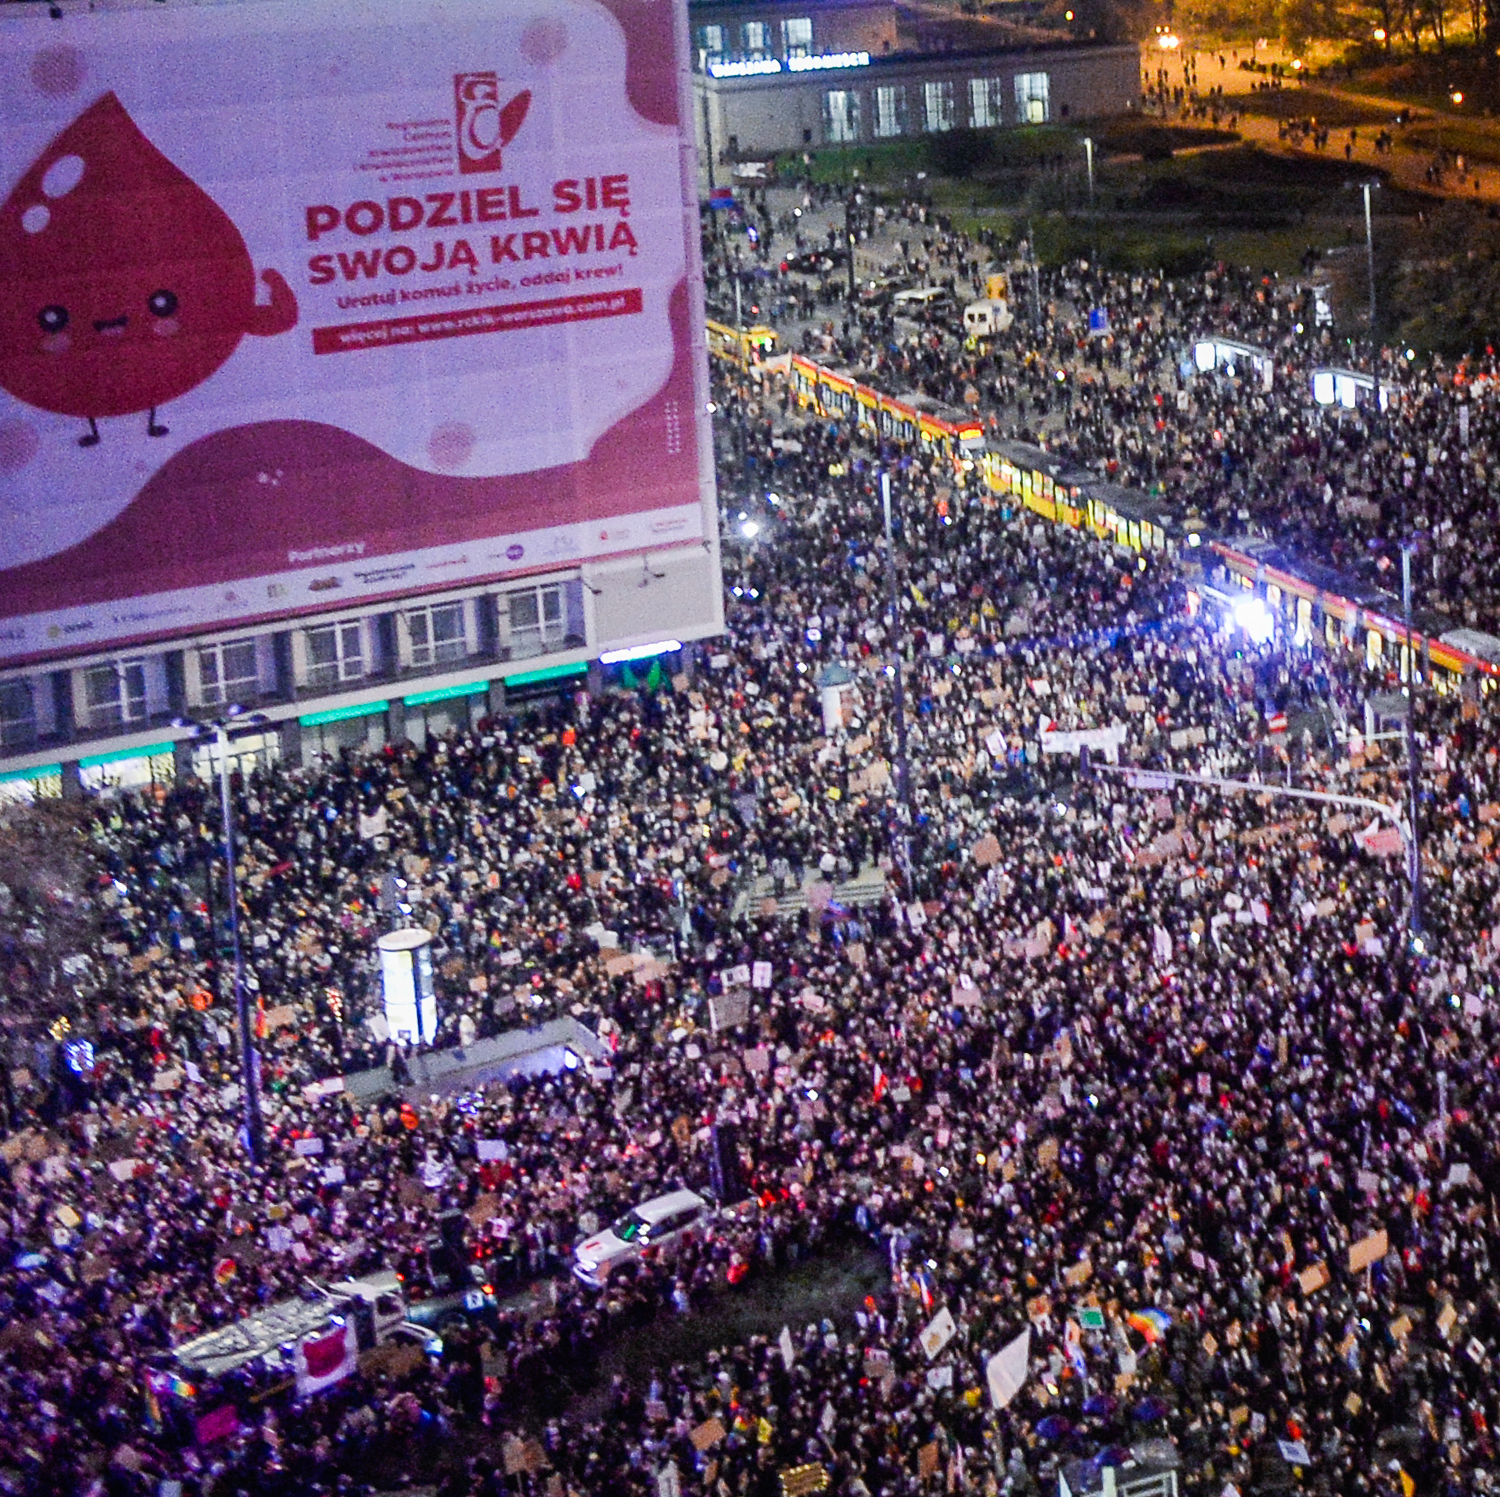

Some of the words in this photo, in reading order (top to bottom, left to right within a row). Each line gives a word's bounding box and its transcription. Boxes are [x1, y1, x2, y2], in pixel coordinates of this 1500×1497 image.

[305, 185, 540, 241] PODZIEL
[552, 173, 632, 217] SIĘ
[308, 238, 480, 285] SWOJĄ
[490, 221, 639, 264] KRWIĄ
[336, 287, 397, 310] Uratuj
[400, 281, 462, 302] komuś
[465, 274, 516, 296] życie,
[519, 269, 572, 288] oddaj
[573, 263, 625, 281] krew!
